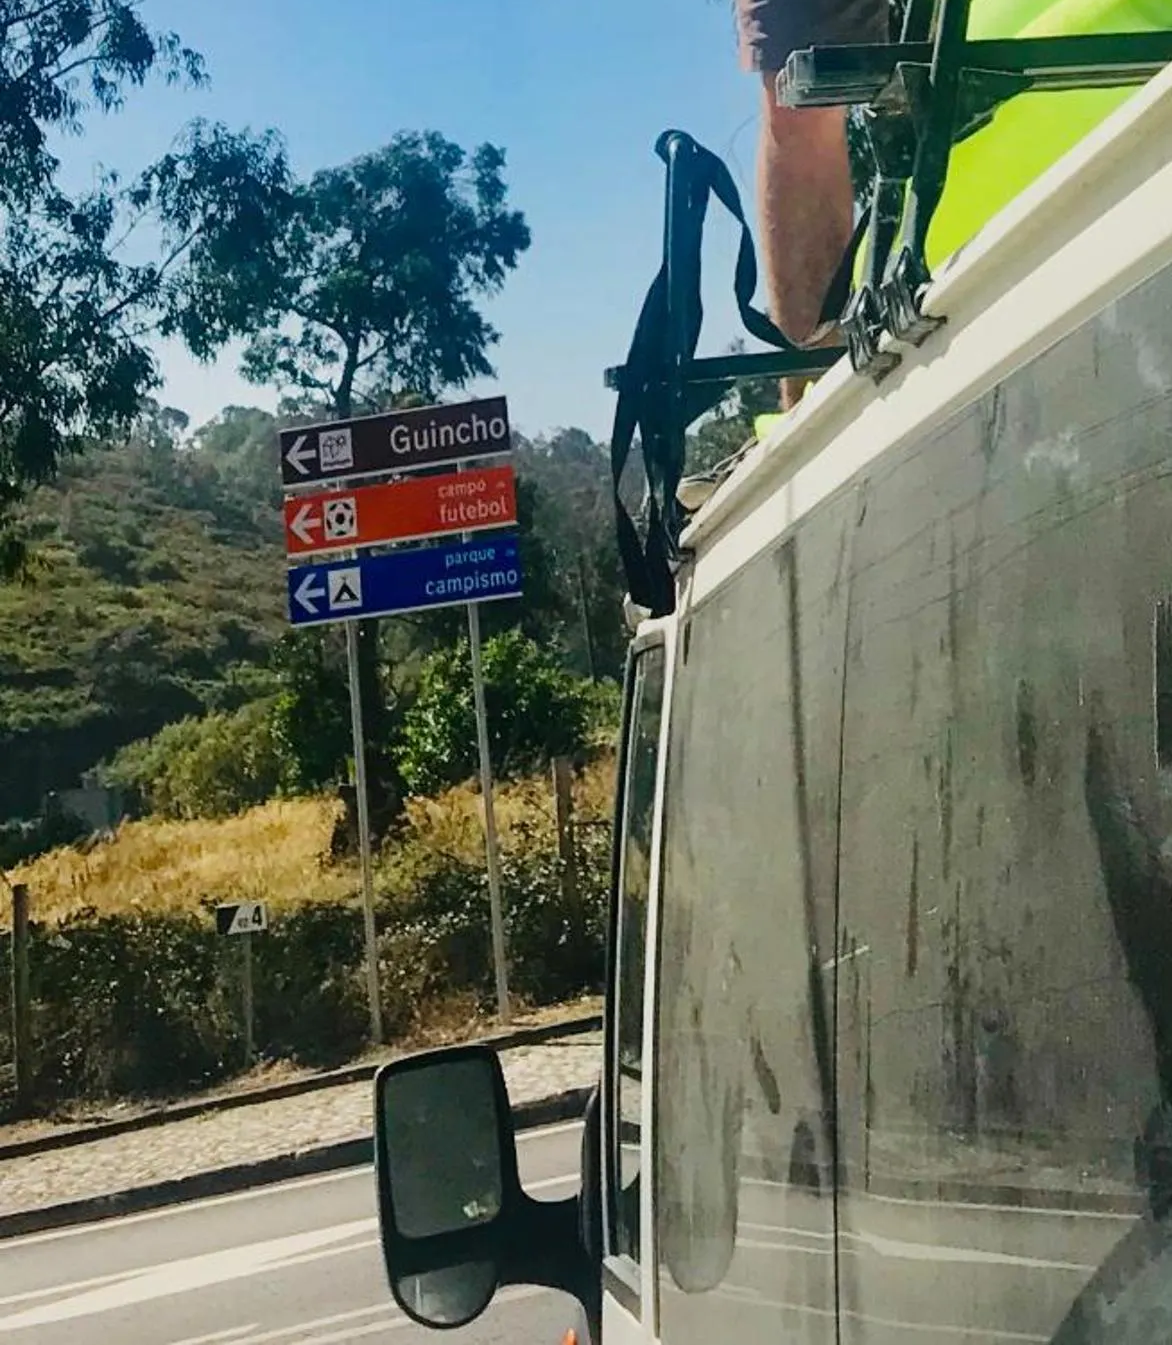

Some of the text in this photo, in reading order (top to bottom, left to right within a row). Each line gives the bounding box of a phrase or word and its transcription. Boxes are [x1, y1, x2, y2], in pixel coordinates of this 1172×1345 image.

[390, 413, 505, 454] Guincho
[438, 479, 487, 498] campo
[439, 495, 508, 523] futebol
[445, 547, 496, 569] parque
[425, 568, 518, 596] campismo
[252, 905, 262, 926] 4
